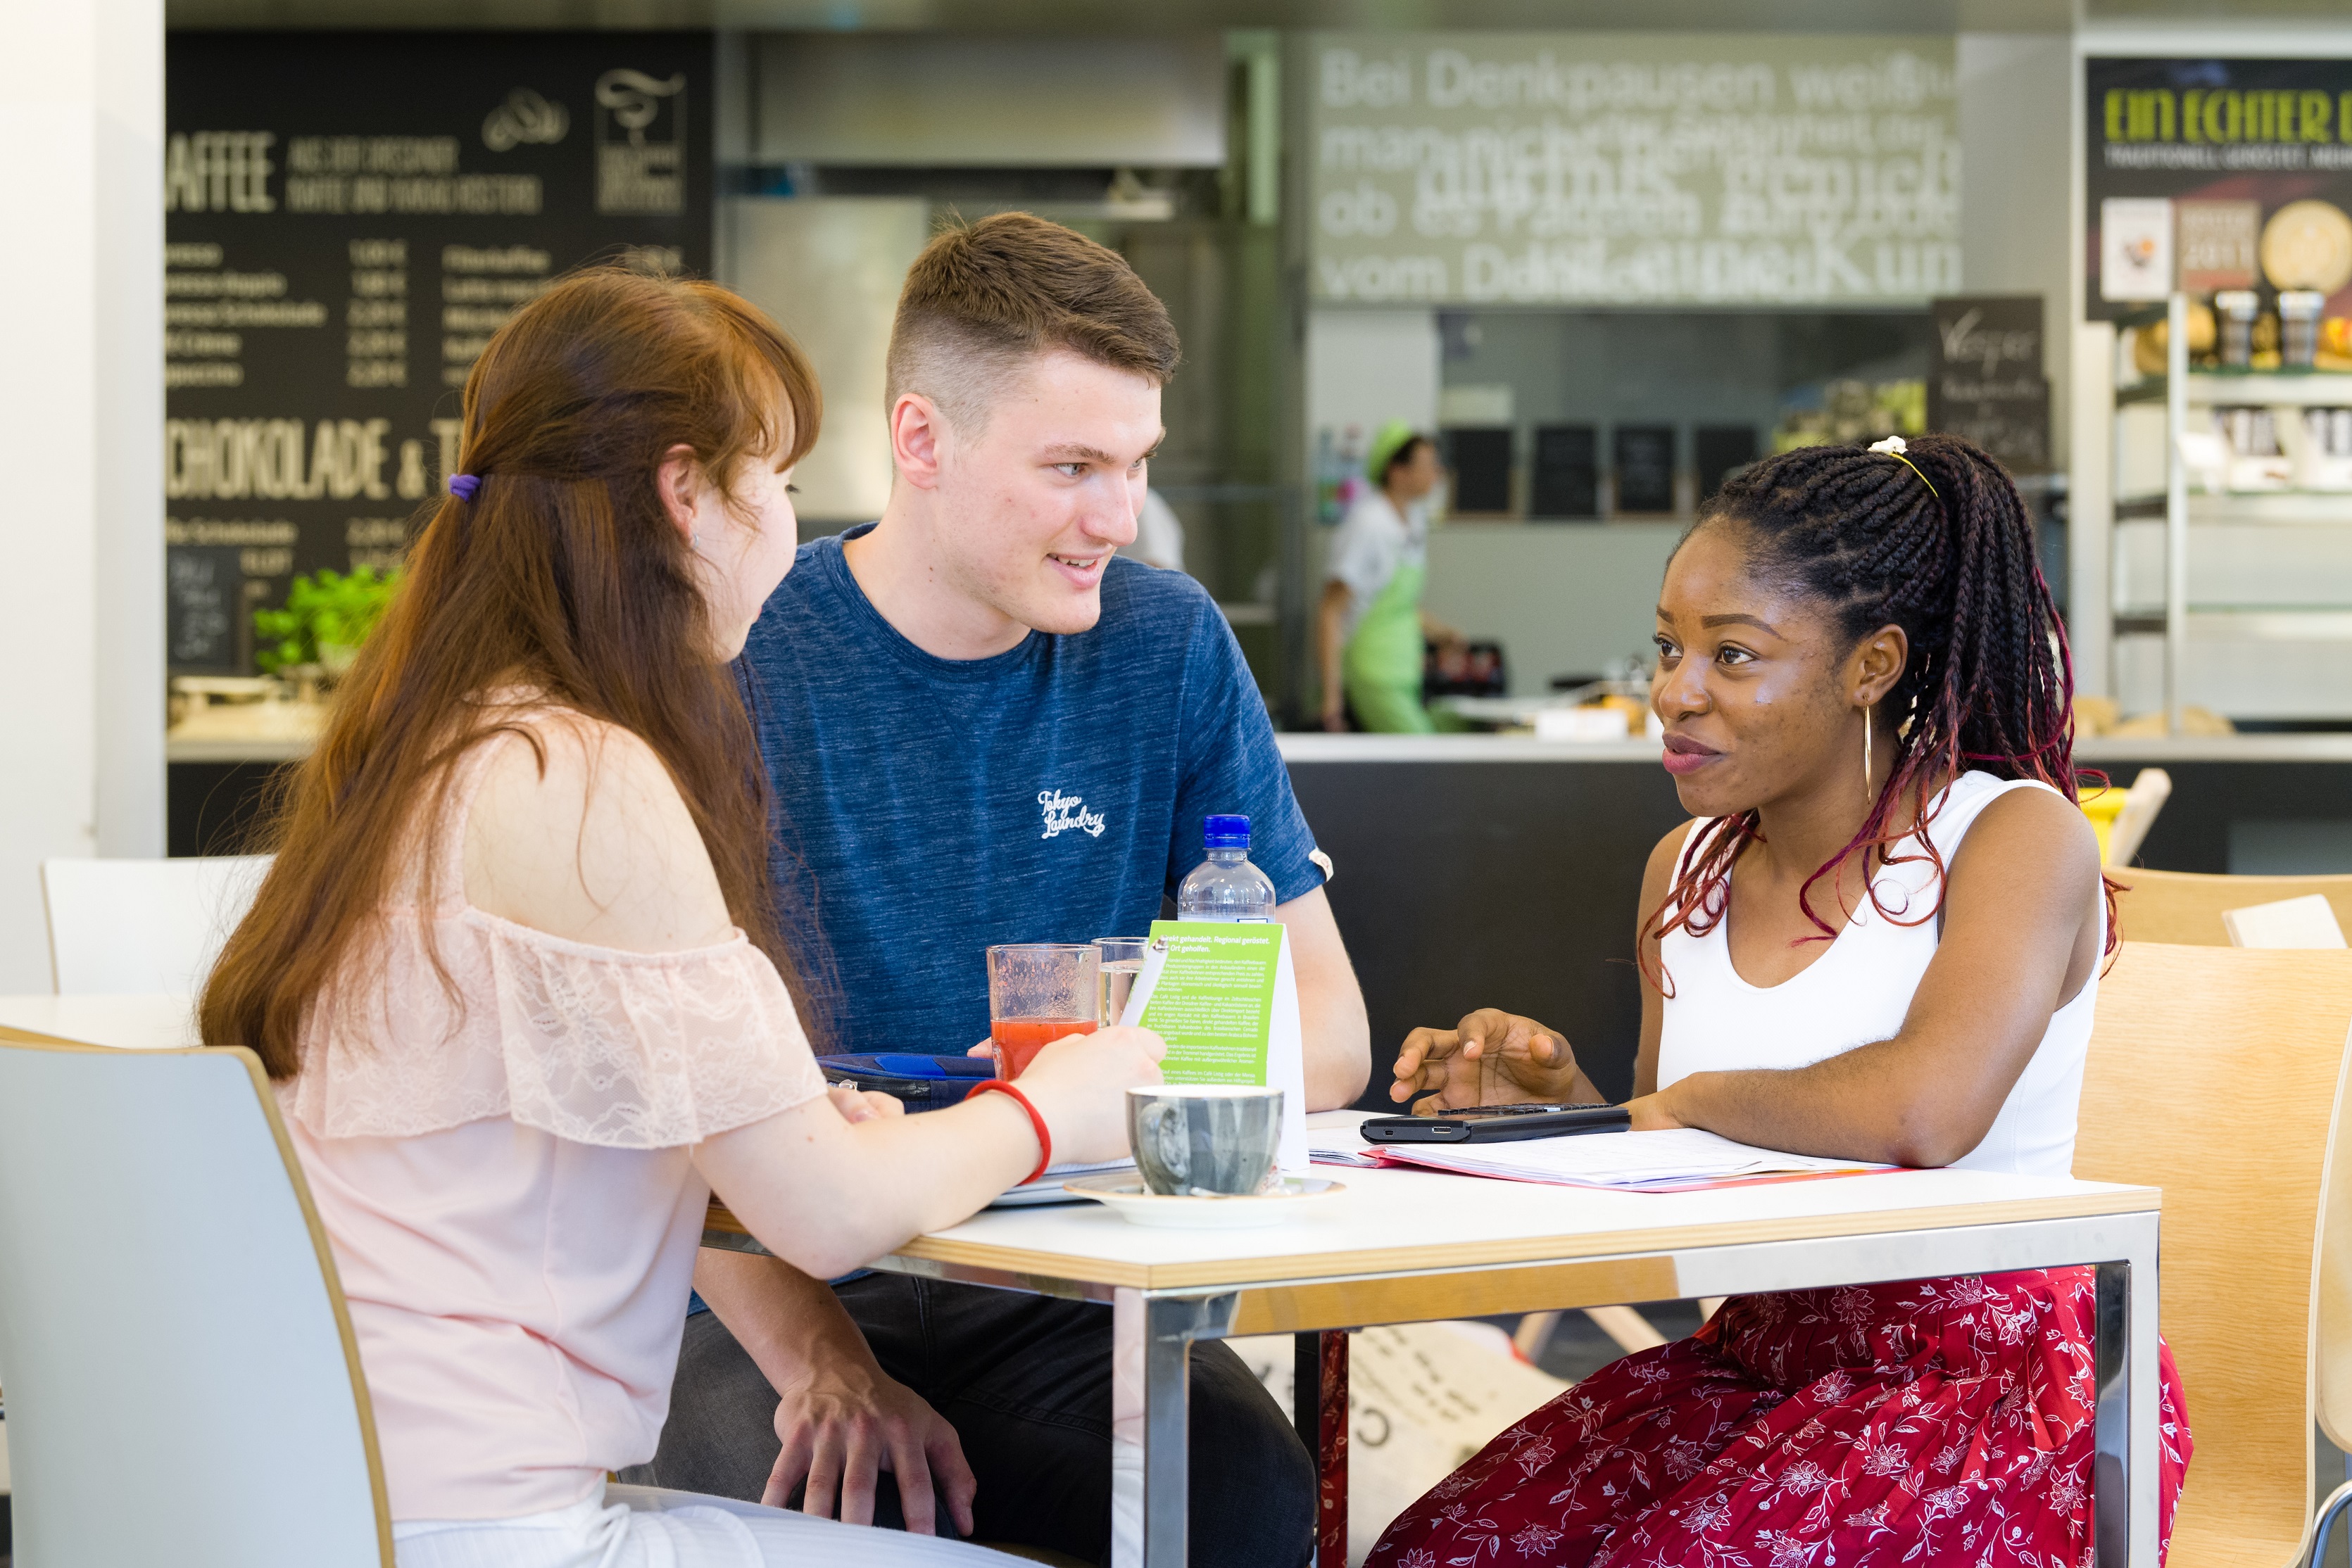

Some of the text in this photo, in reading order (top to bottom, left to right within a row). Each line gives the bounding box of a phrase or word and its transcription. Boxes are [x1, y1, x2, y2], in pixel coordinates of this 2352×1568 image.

[1321, 51, 1409, 106] Bei
[1428, 49, 1774, 115] Denkpausen
[2182, 89, 2333, 143] ECHTER
[166, 421, 389, 498] CHOKOLADE
[1038, 788, 1082, 820] Tokyo
[1041, 804, 1105, 839] Laundry
